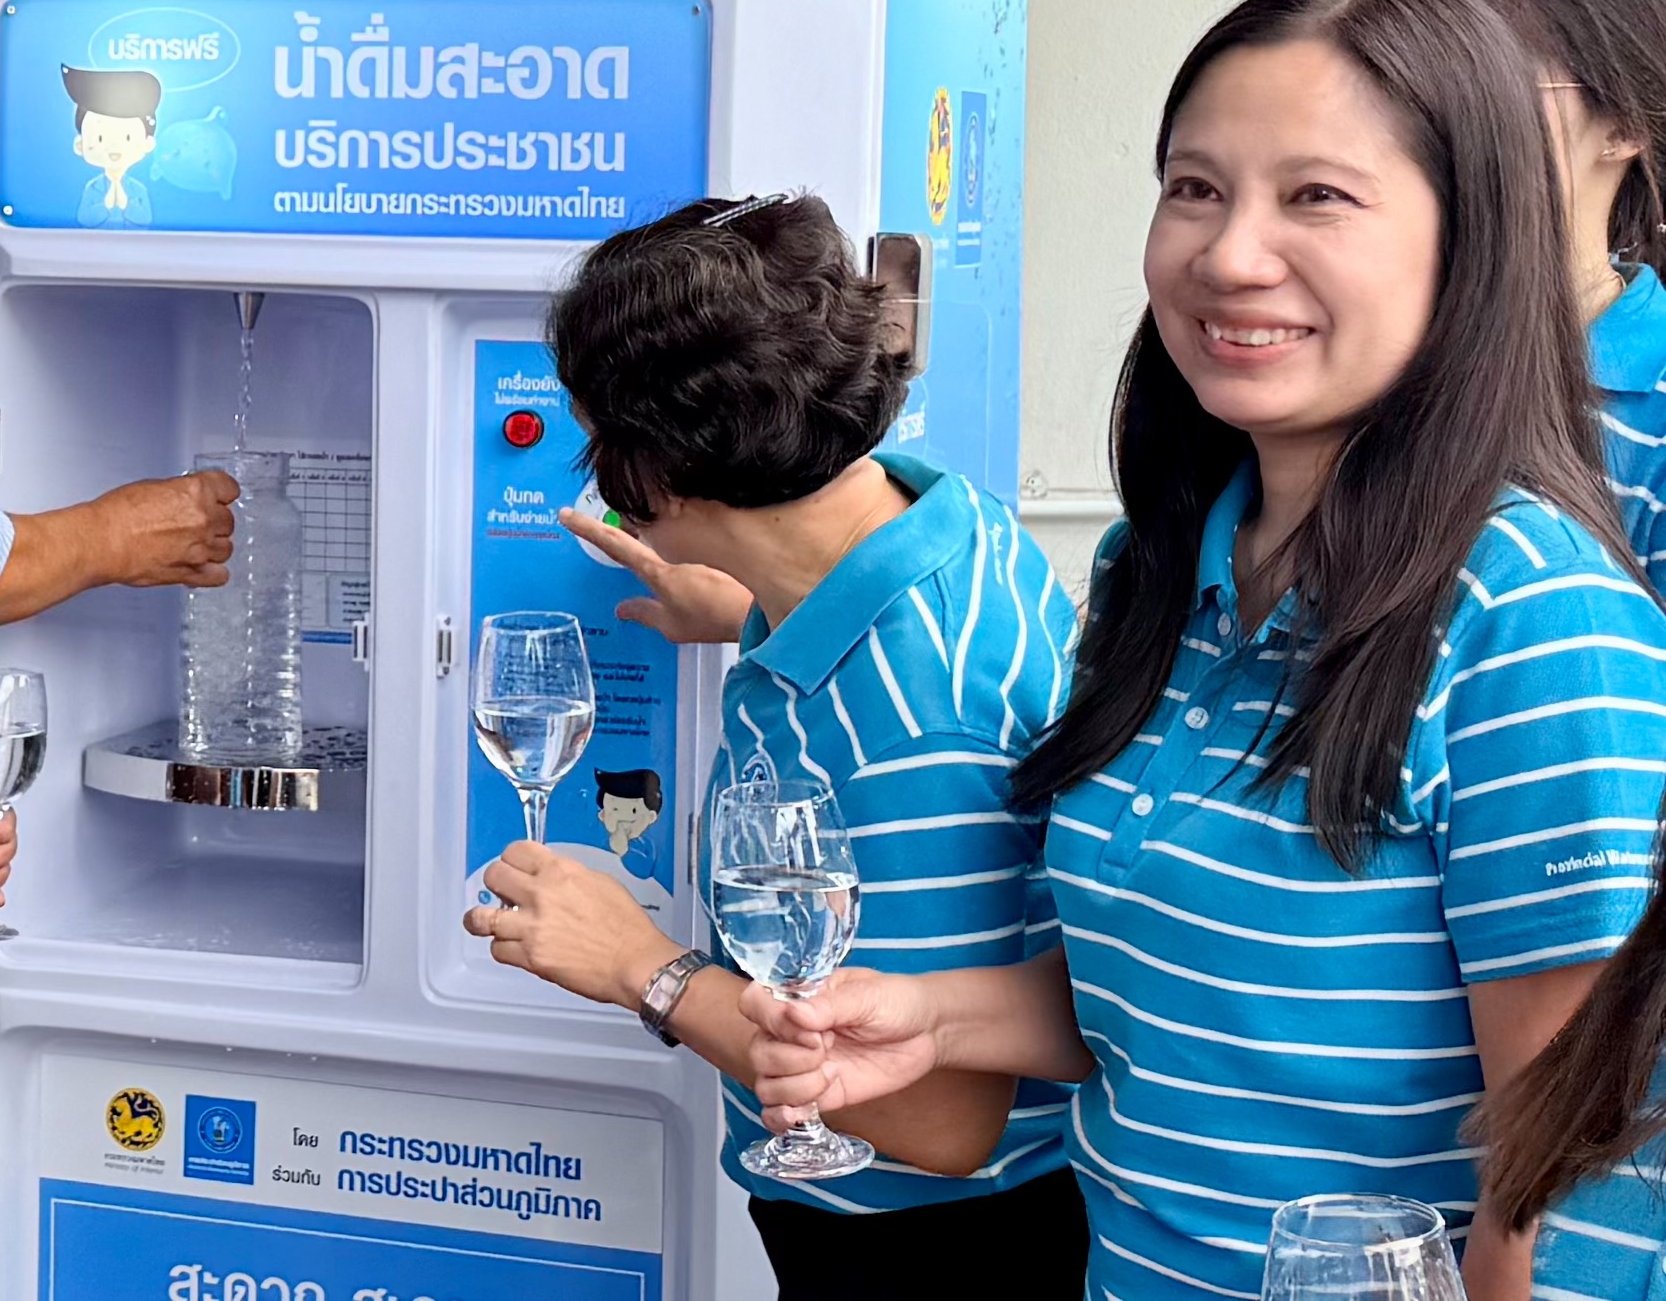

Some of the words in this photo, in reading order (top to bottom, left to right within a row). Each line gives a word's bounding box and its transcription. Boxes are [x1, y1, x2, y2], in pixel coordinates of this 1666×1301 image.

[107, 30, 220, 62] บริการฟรี
[274, 10, 629, 100] น้ำดื่มสะอาด
[275, 119, 625, 171] บริการประชาชน
[274, 183, 625, 219] ตามนโยบายกระทรวงมหาดไทย
[292, 1126, 319, 1148] โดย
[338, 1129, 583, 1181] กระทรวงมหาดไทย
[271, 1165, 322, 1186] ร่วมกับ
[337, 1165, 602, 1222] การประปาส่วนภูมิภาค
